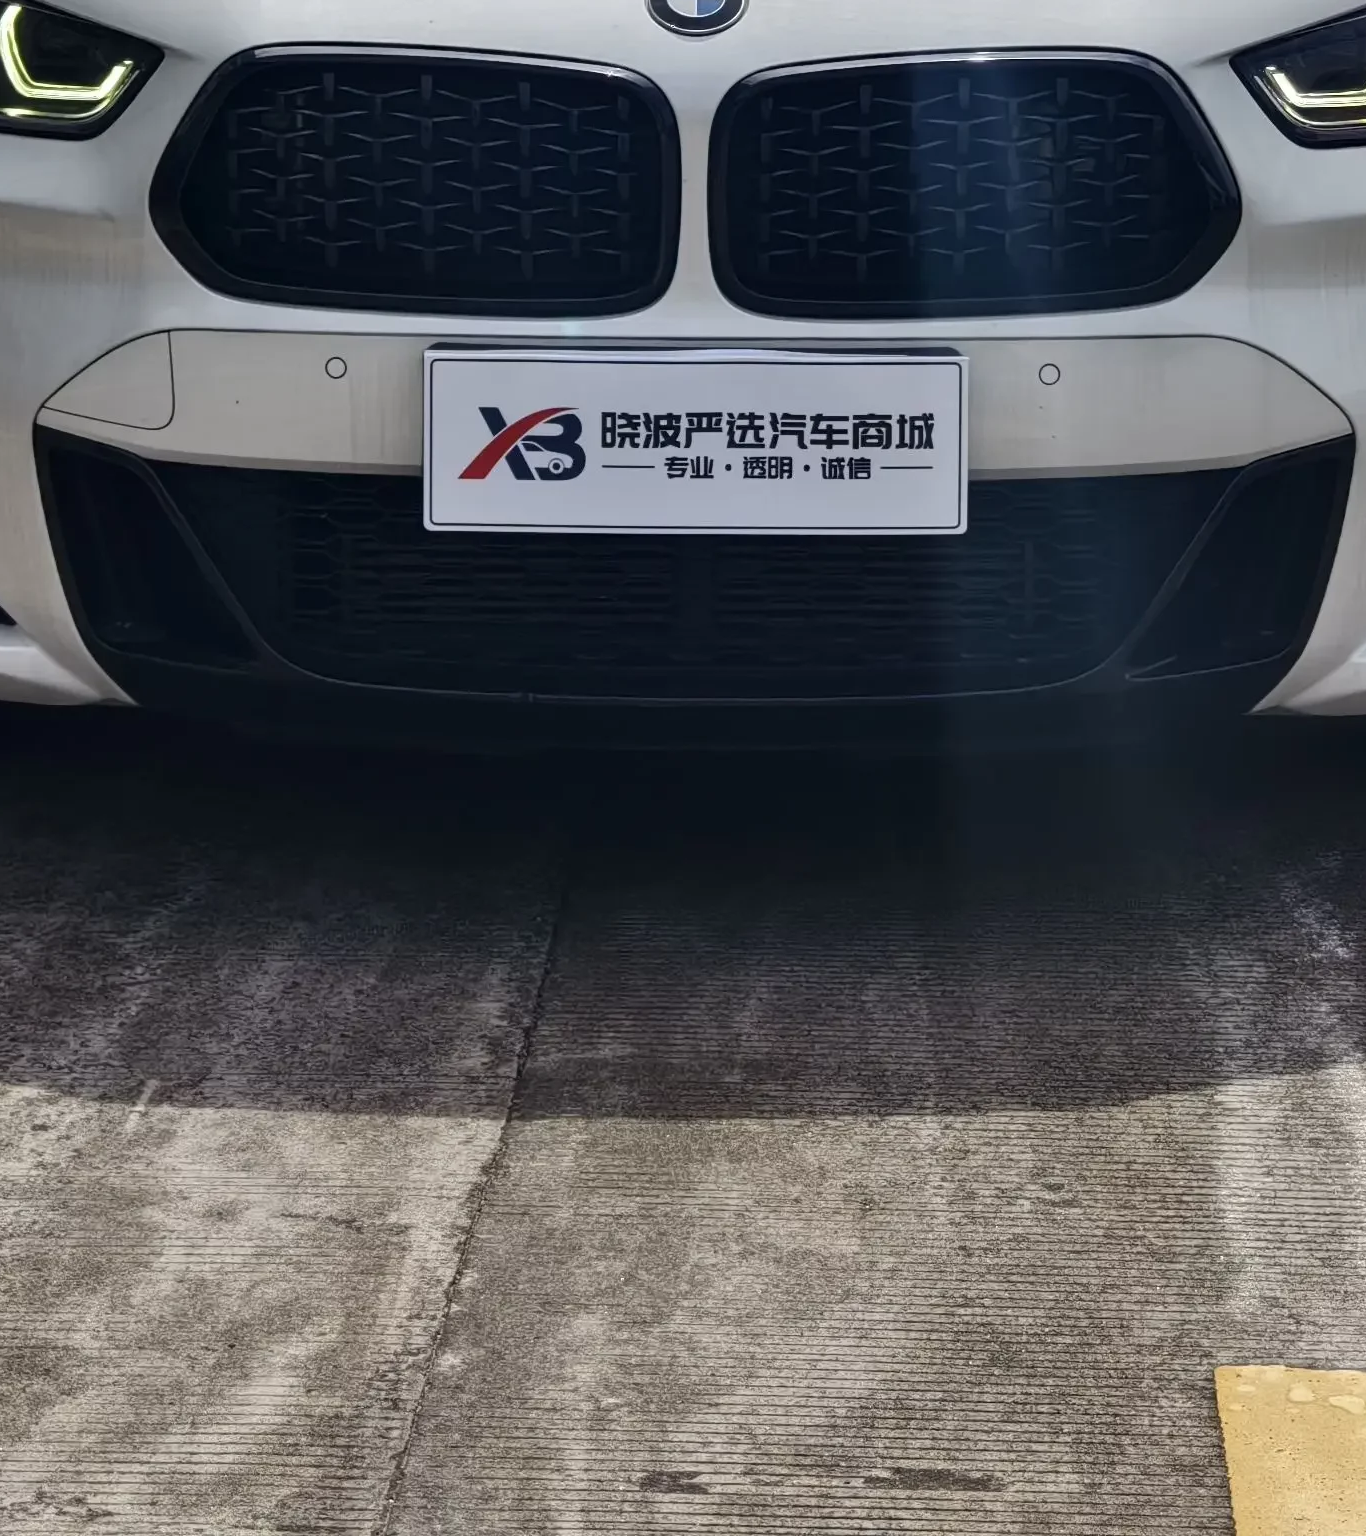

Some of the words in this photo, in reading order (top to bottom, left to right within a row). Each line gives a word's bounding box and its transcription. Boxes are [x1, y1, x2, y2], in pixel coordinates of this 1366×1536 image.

[600, 411, 935, 450] 晓波严选汽车商城
